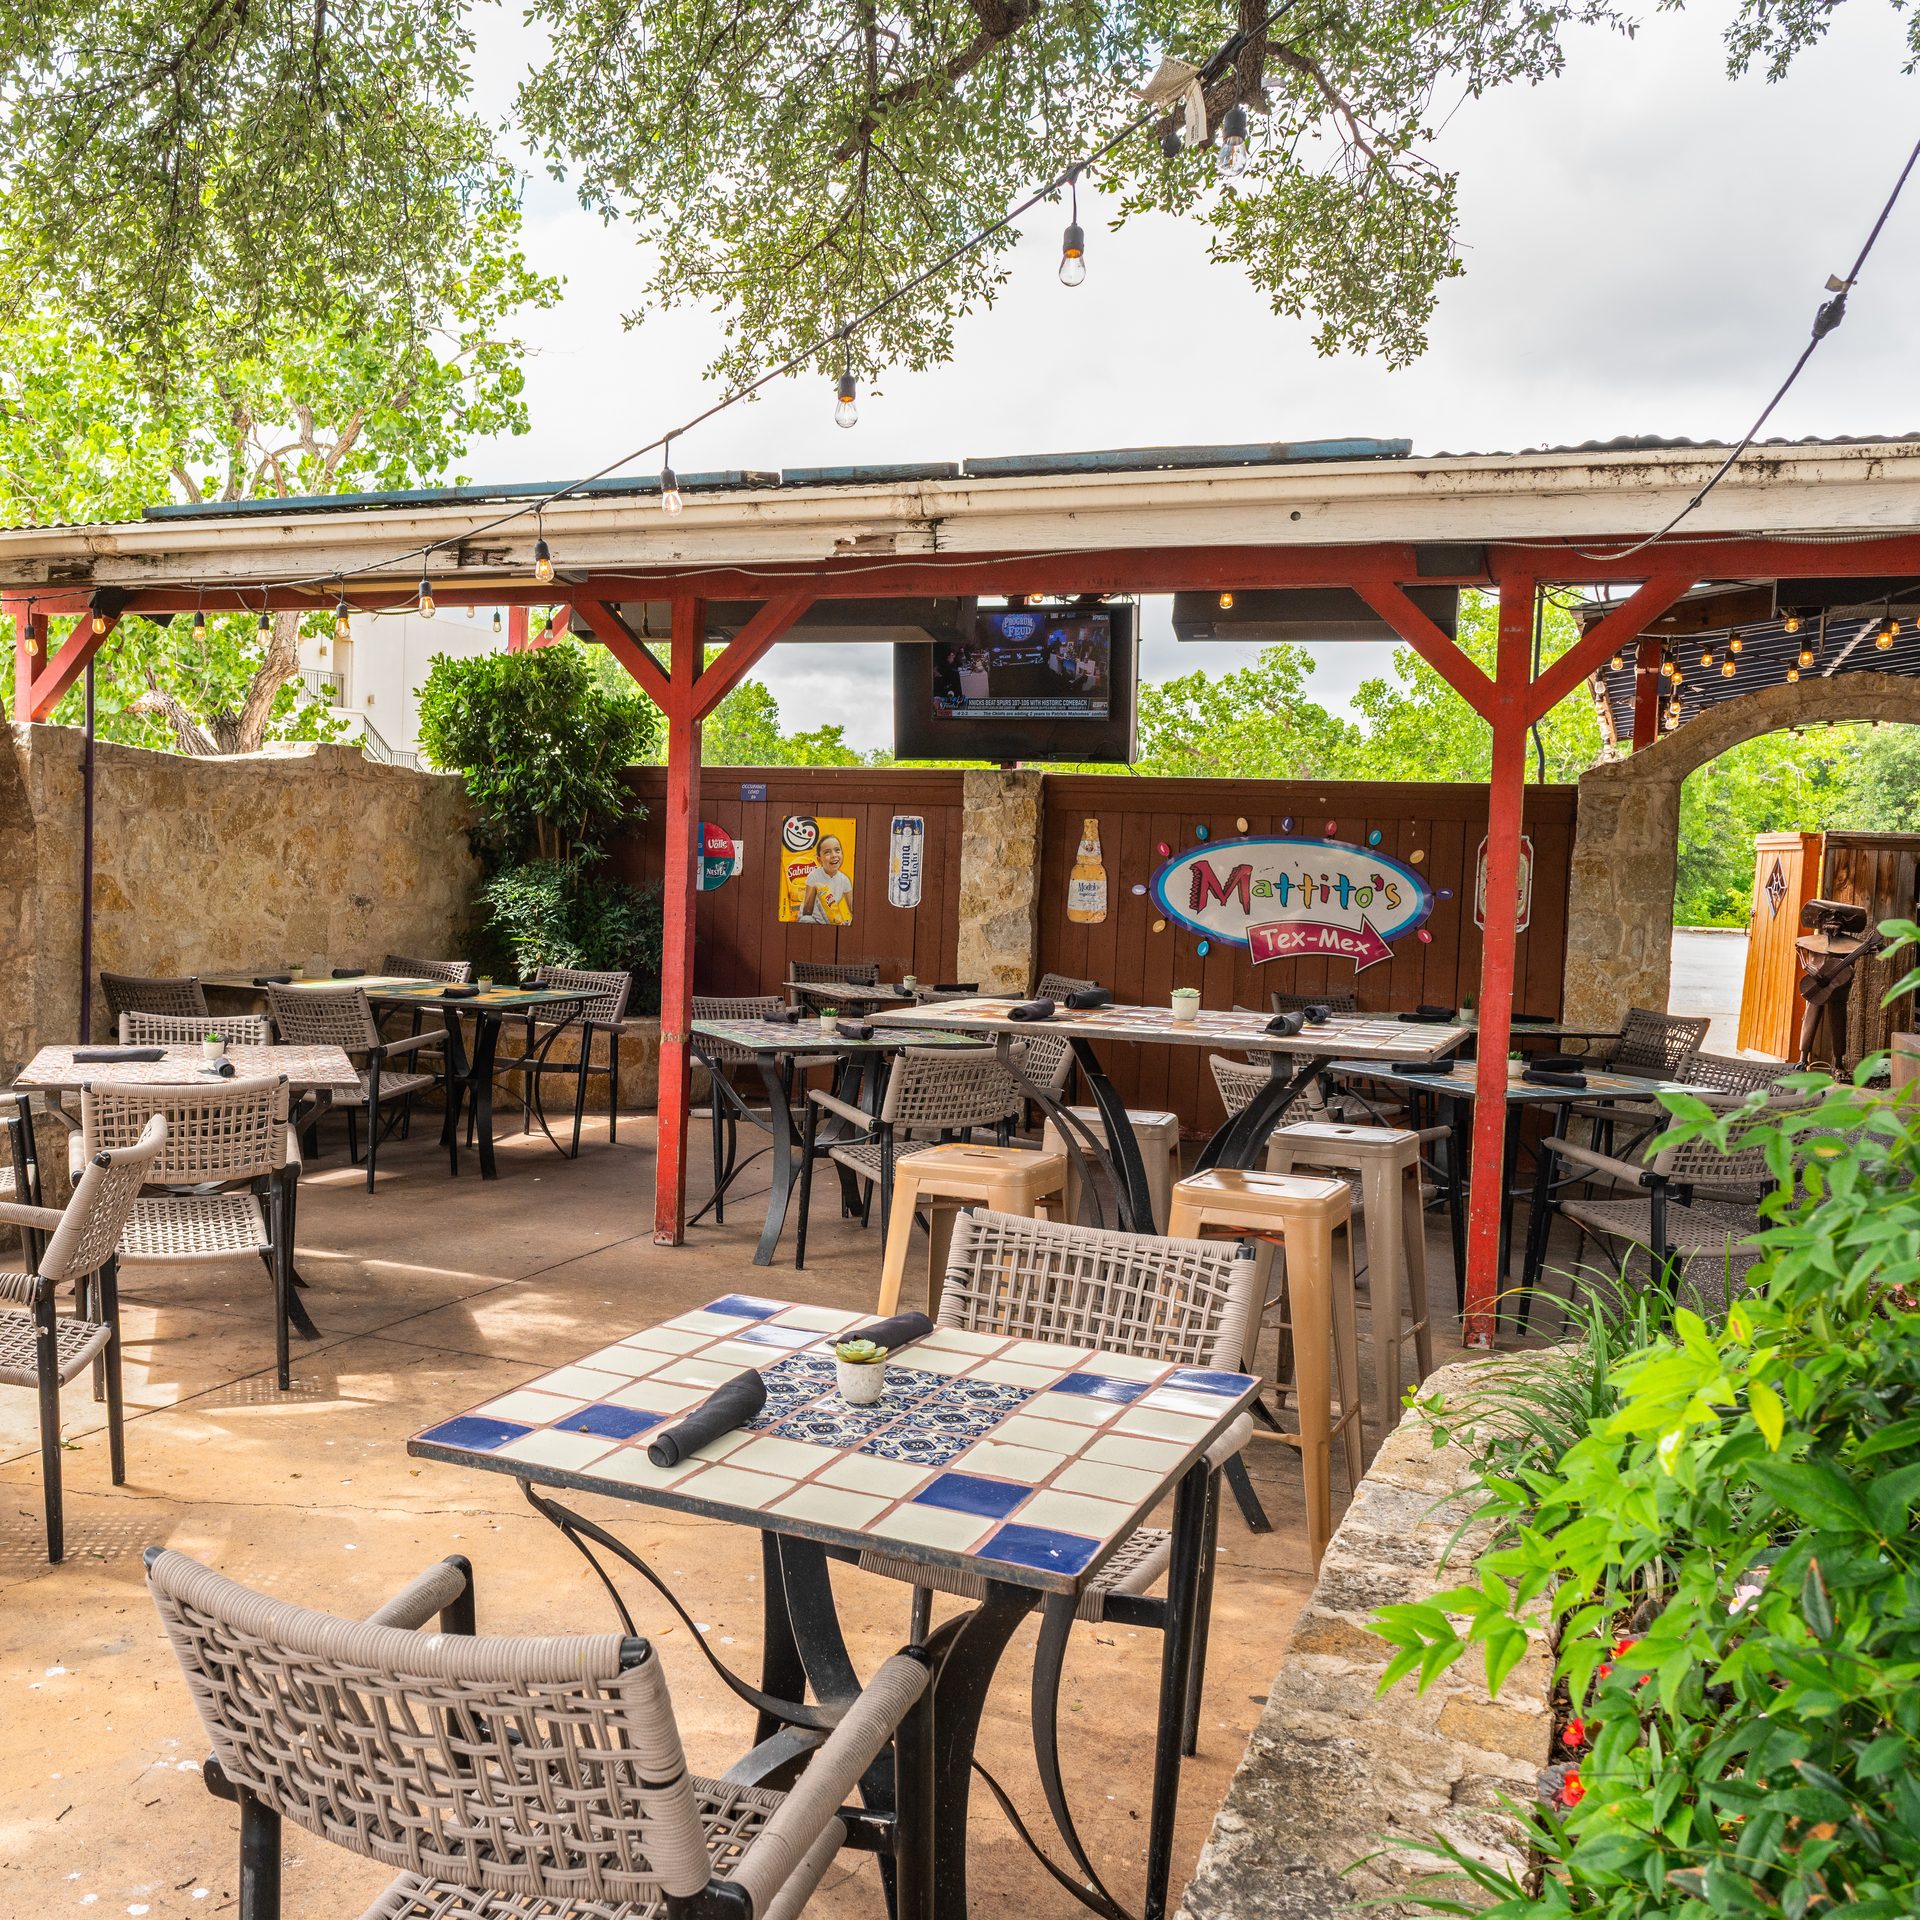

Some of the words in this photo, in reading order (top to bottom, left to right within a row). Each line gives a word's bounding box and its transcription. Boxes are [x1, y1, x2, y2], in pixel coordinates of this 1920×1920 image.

[1007, 625, 1032, 637] FEUD
[788, 865, 815, 878] Sabrita
[898, 845, 912, 892] Corona
[910, 852, 919, 878] Light
[1189, 860, 1402, 915] Mattito's
[1259, 928, 1371, 955] Tex-Mex
